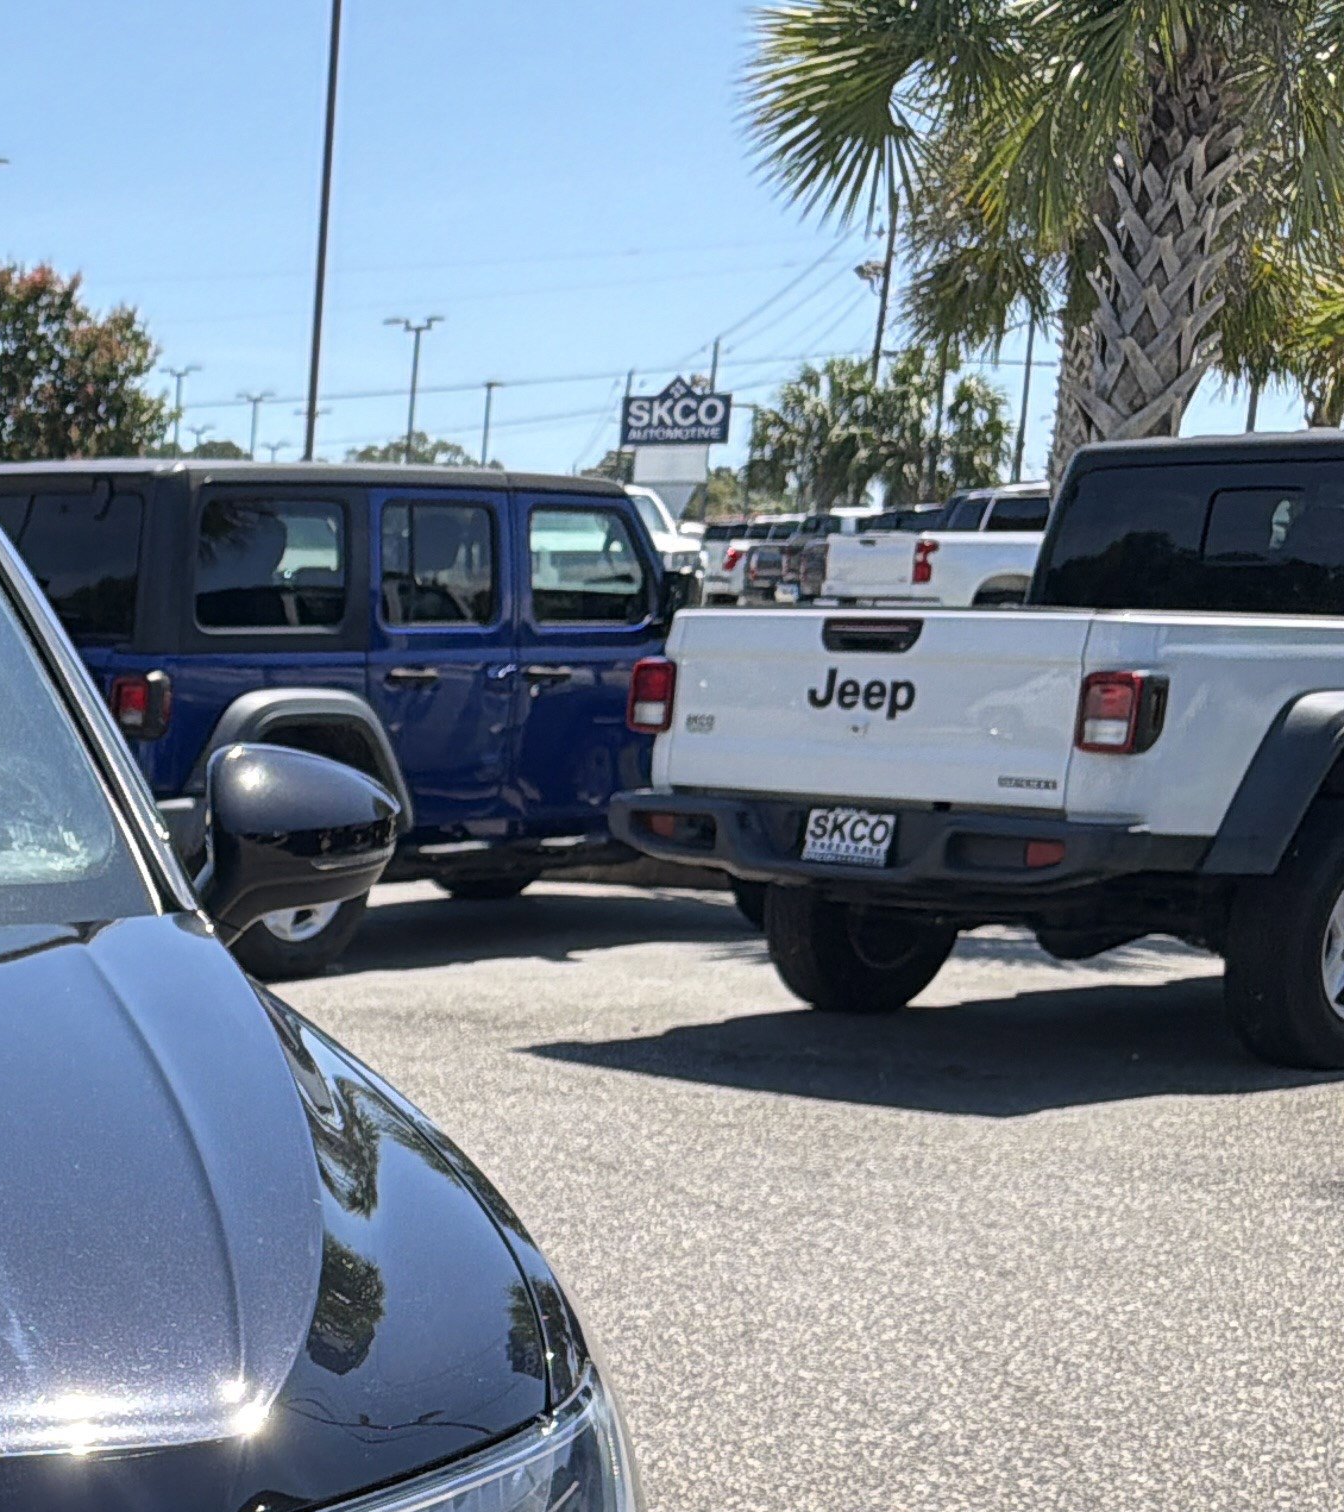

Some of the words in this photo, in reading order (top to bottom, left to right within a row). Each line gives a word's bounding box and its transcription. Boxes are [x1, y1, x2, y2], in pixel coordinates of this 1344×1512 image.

[628, 398, 725, 427] SKCO
[627, 426, 722, 440] AUTOMOTIVE
[807, 667, 916, 720] Jeep
[809, 814, 890, 846] SKCO
